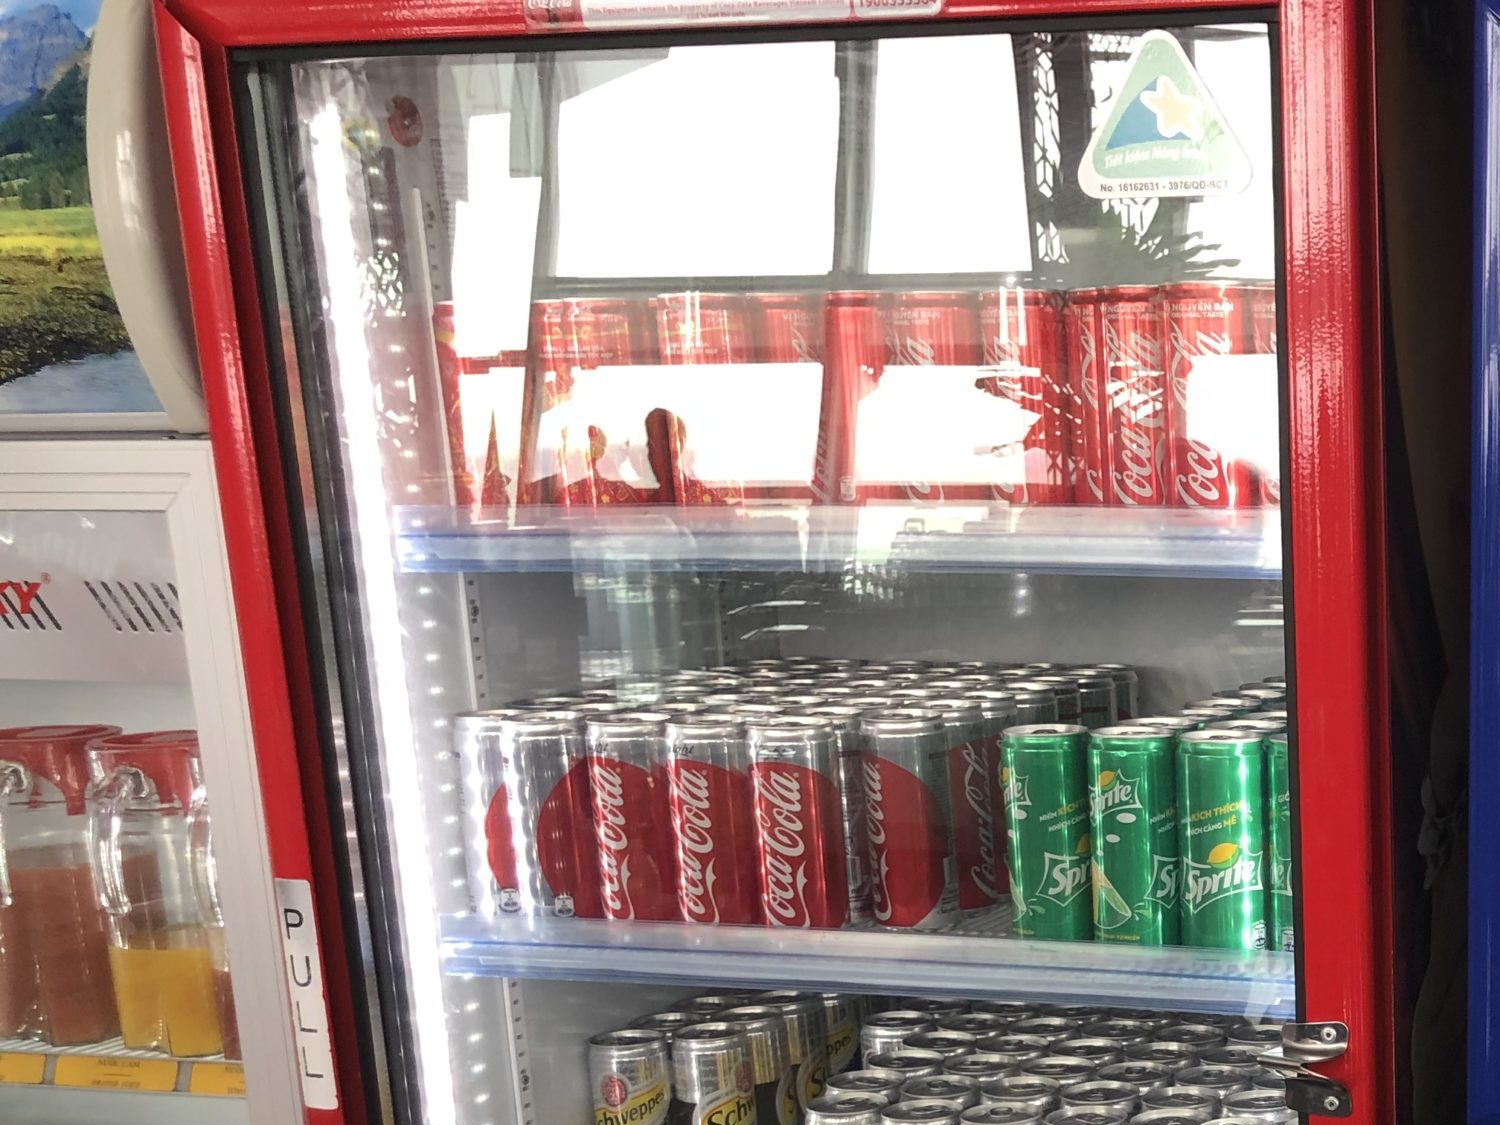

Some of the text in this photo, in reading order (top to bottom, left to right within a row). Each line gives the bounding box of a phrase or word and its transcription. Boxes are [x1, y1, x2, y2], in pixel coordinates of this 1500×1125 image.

[1118, 180, 1160, 192] 16162631
[1185, 855, 1256, 905] Sprite
[283, 908, 325, 1080] PULL
